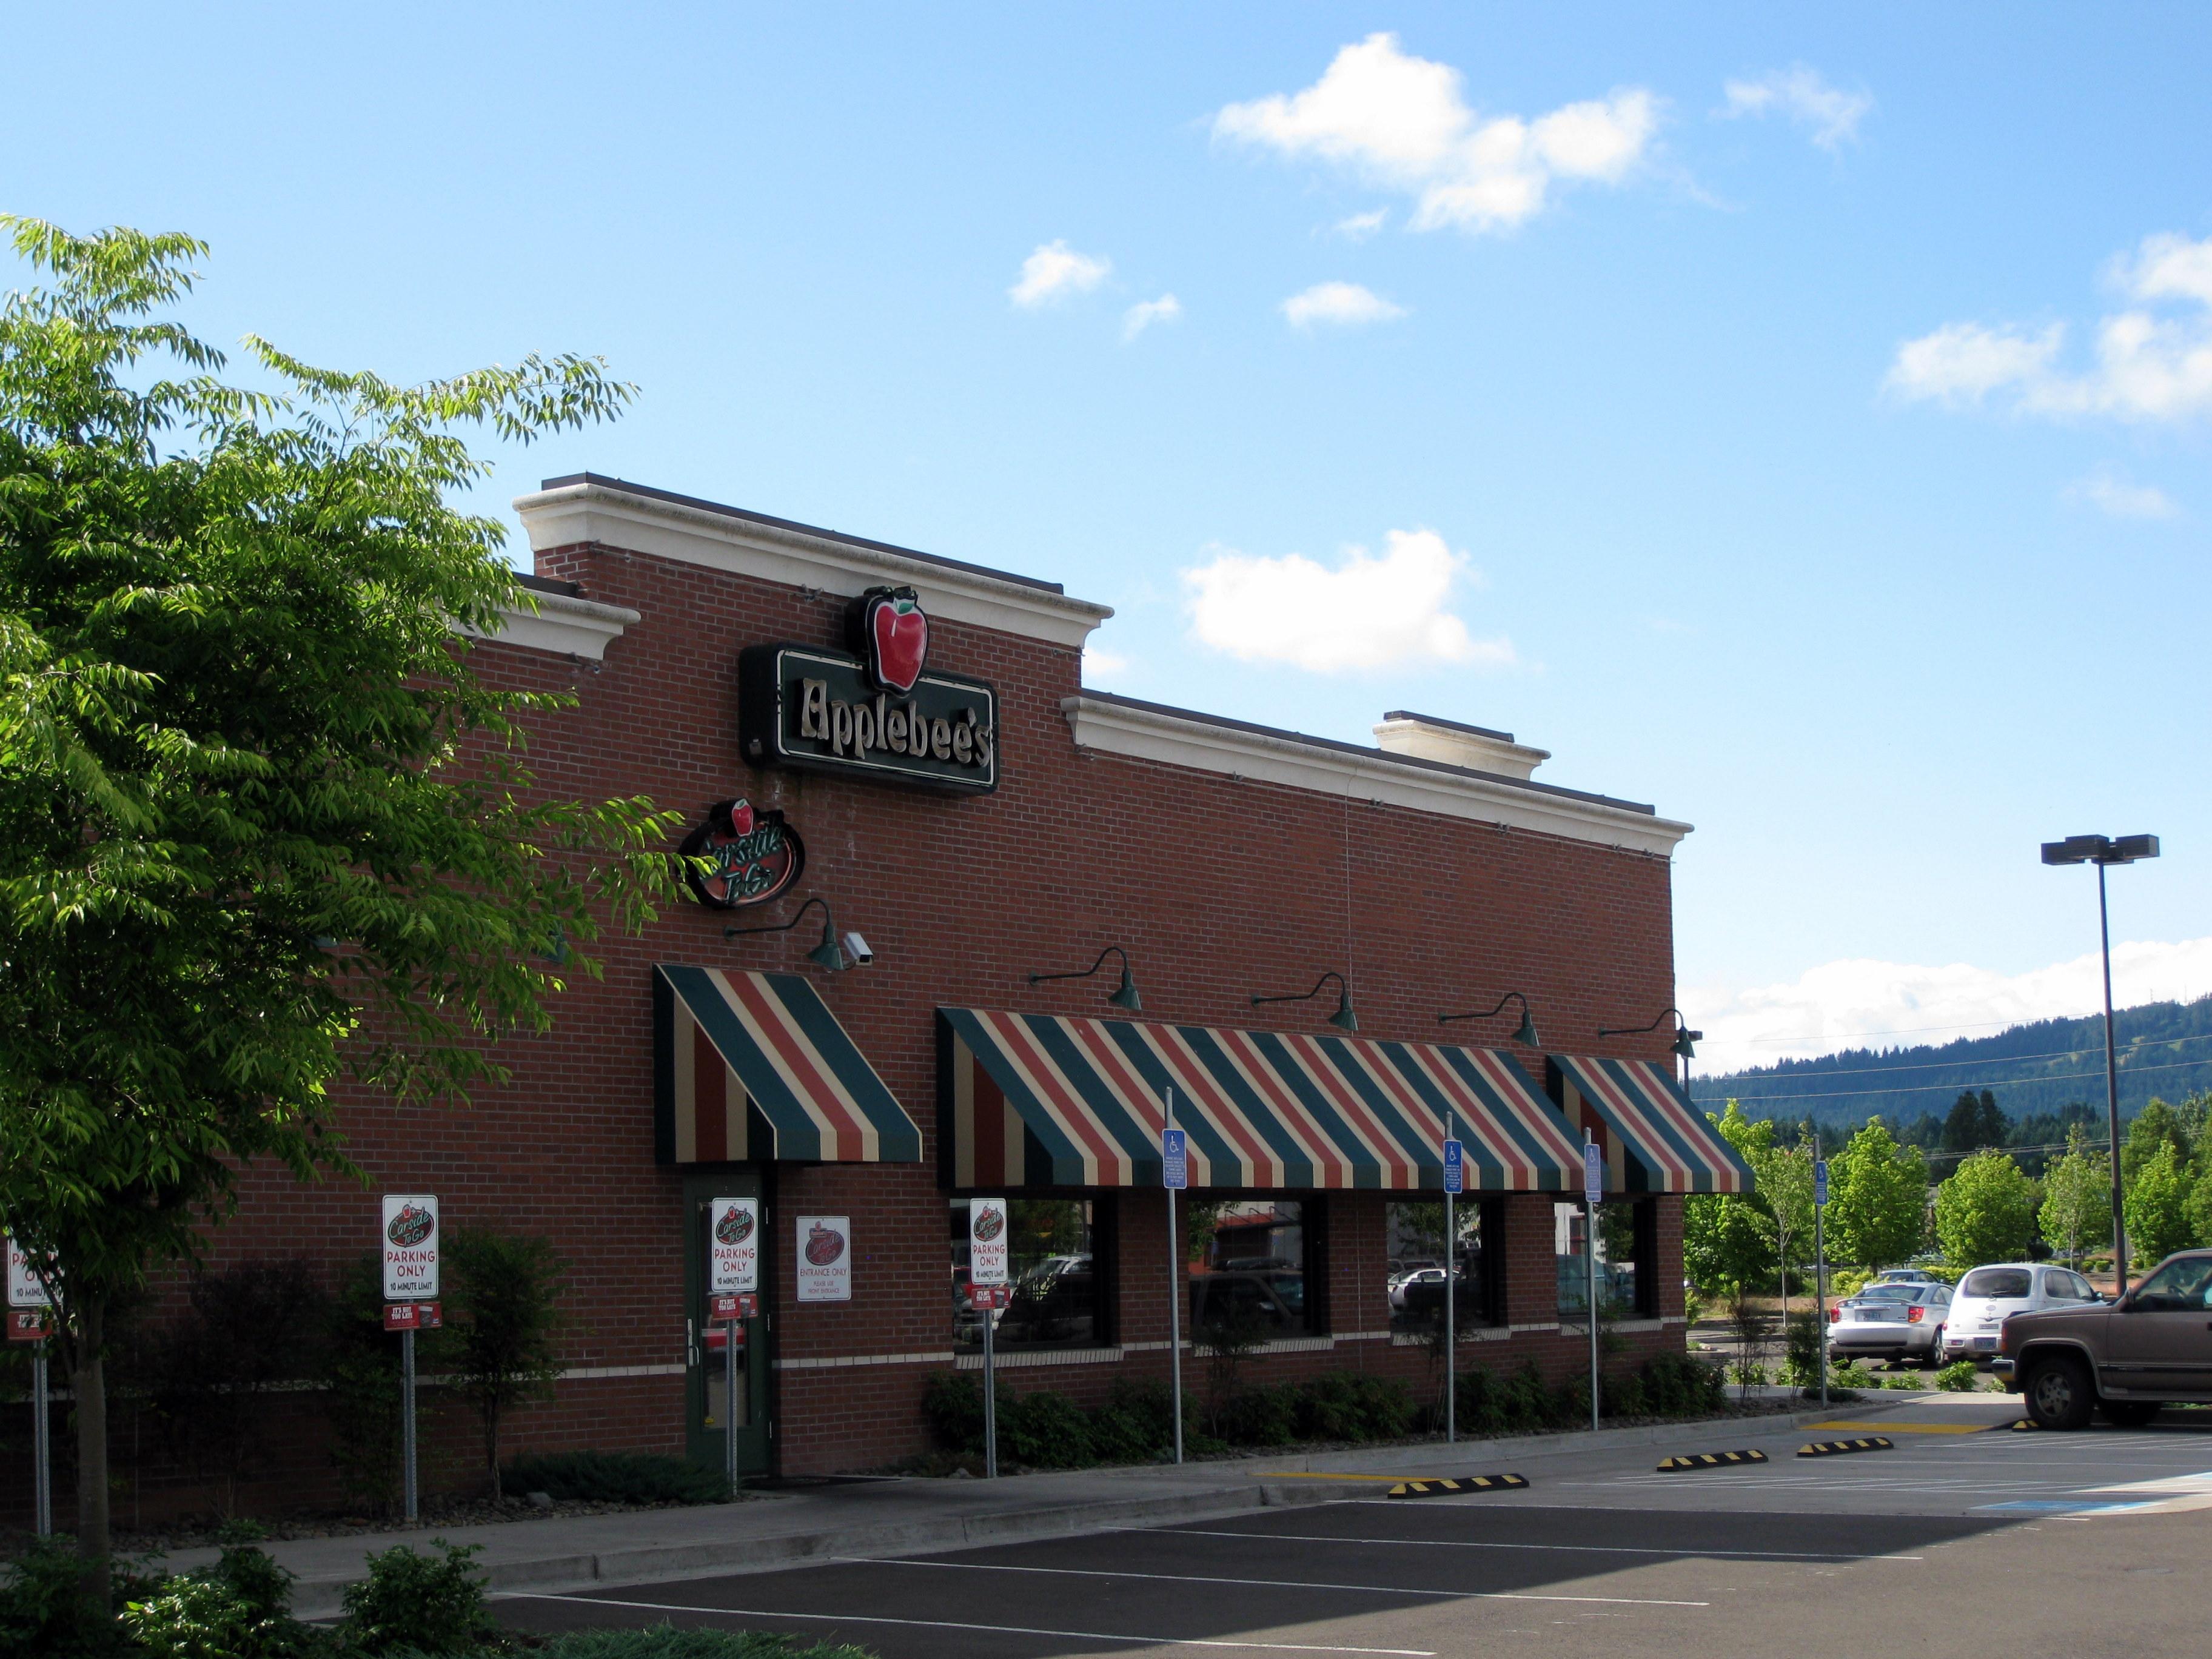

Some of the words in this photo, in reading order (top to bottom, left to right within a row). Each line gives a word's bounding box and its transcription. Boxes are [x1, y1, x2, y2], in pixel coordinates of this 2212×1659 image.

[802, 677, 993, 768] Applebee's
[389, 1206, 430, 1239] Carside
[717, 1208, 750, 1237] Carside
[974, 1207, 1001, 1235] Carside
[403, 1233, 411, 1247] To
[412, 1228, 424, 1242] Go
[728, 1232, 735, 1243] To
[736, 1228, 746, 1241] Go
[715, 1248, 755, 1259] PARKING
[973, 1244, 1005, 1255] PARKING
[387, 1251, 435, 1262] PARKING
[980, 1256, 999, 1266] ONLY
[397, 1265, 426, 1277] ONLY
[723, 1261, 748, 1272] ONLY
[800, 1268, 830, 1276] ENTRANCE
[832, 1268, 847, 1276] ONLY
[397, 1282, 417, 1291] MINUTE
[418, 1281, 432, 1290] LIMIT
[723, 1276, 740, 1285] MINUTE
[740, 1276, 752, 1284] LIMIT
[16, 1288, 24, 1296] 10
